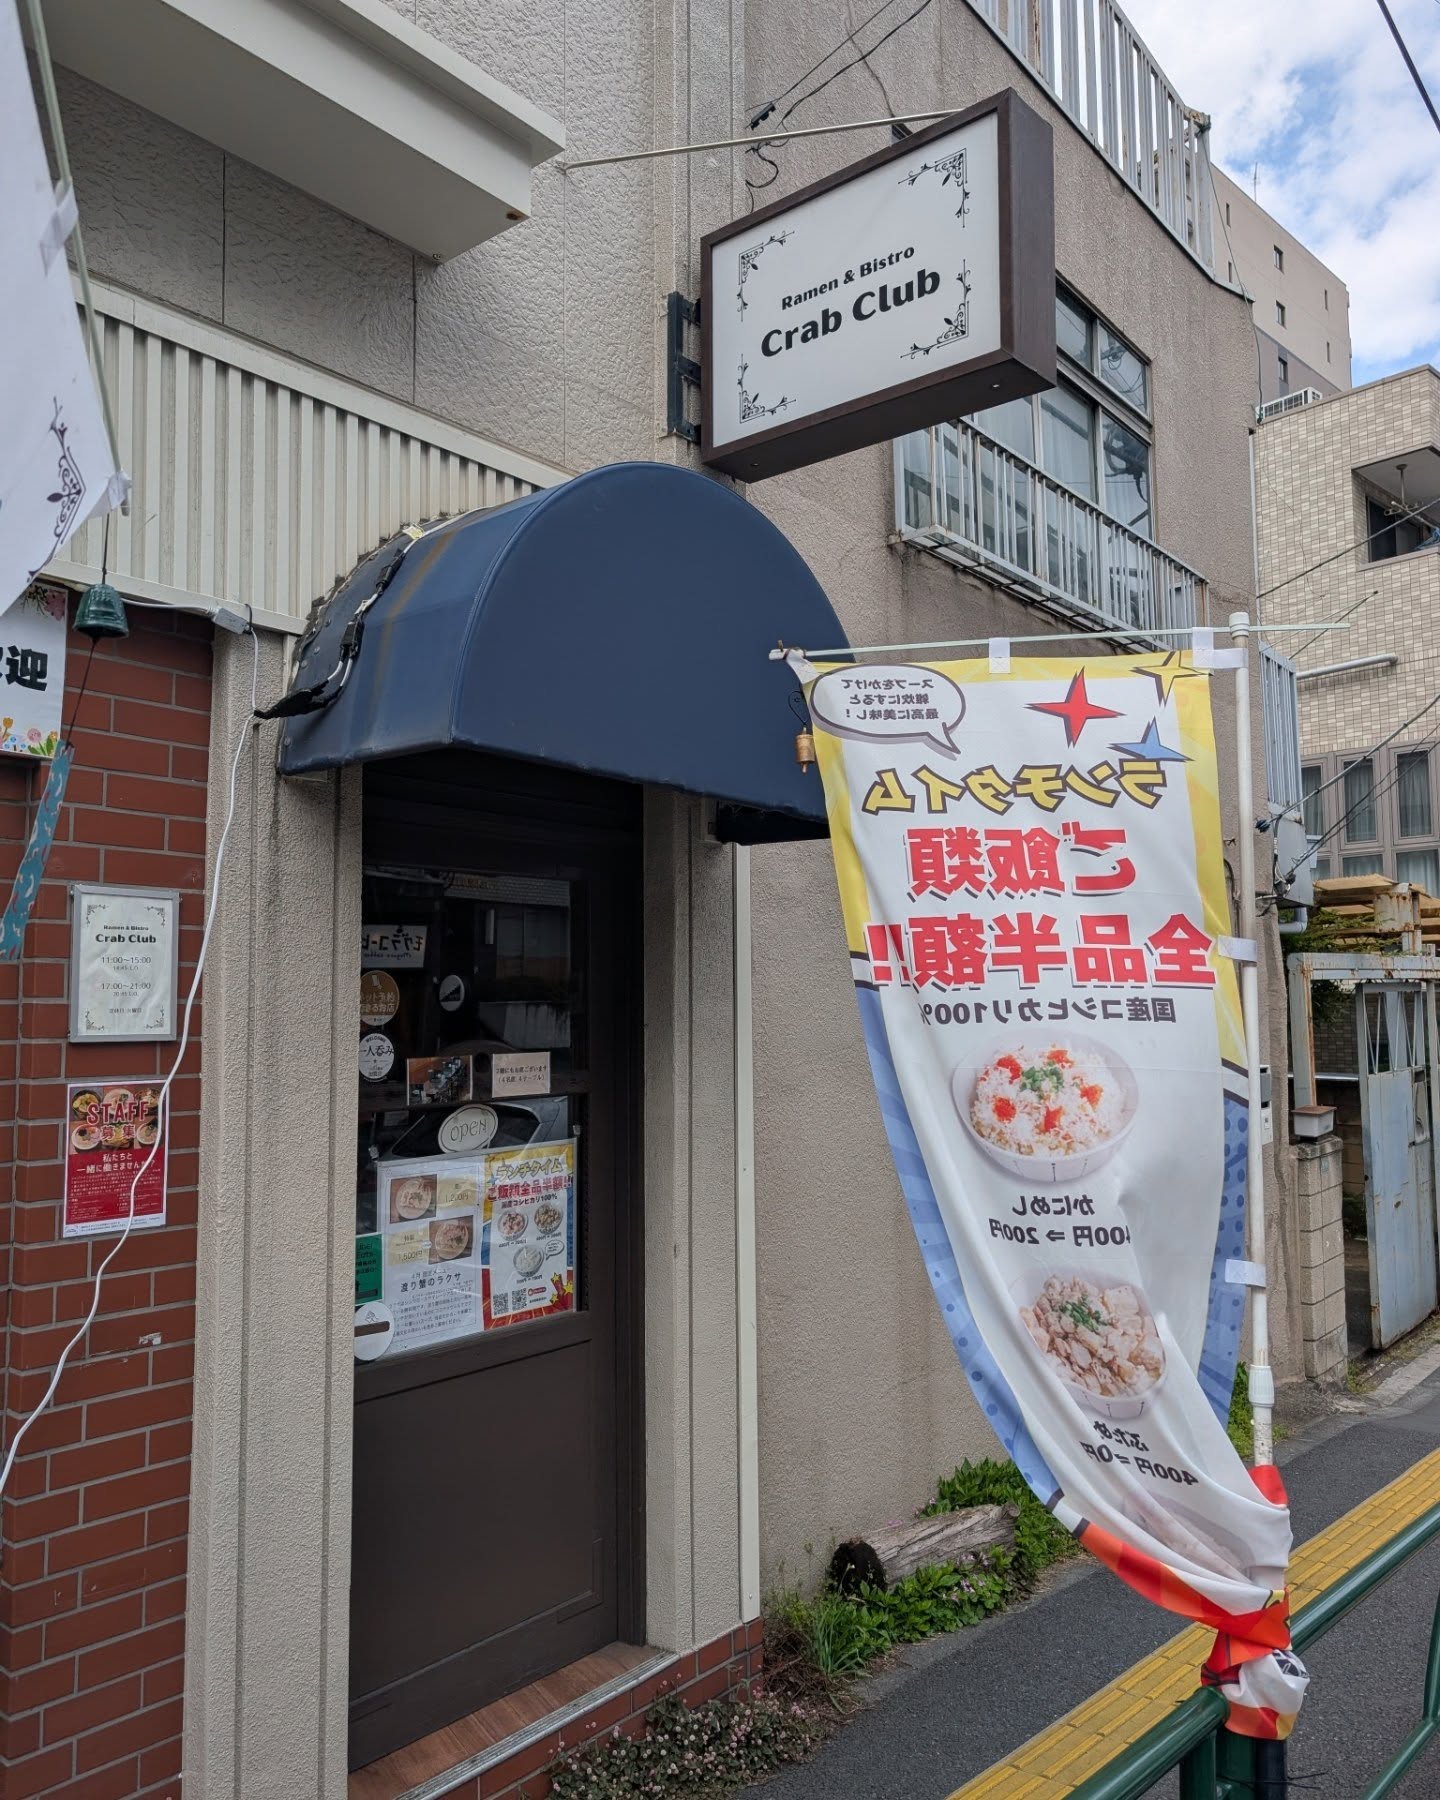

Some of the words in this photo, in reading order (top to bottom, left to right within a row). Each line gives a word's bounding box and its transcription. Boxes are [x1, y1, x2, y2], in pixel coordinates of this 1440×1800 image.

[781, 275, 839, 310] Ramen
[843, 269, 856, 285] &
[859, 246, 915, 278] Bistro
[761, 308, 842, 358] Crab
[852, 268, 940, 322] Club
[0, 645, 49, 692] 迎
[95, 933, 125, 943] Crab
[128, 934, 157, 943] Club
[87, 1100, 149, 1125] STAFF
[101, 1124, 136, 1140] 募集
[102, 1152, 133, 1163] 私たちと
